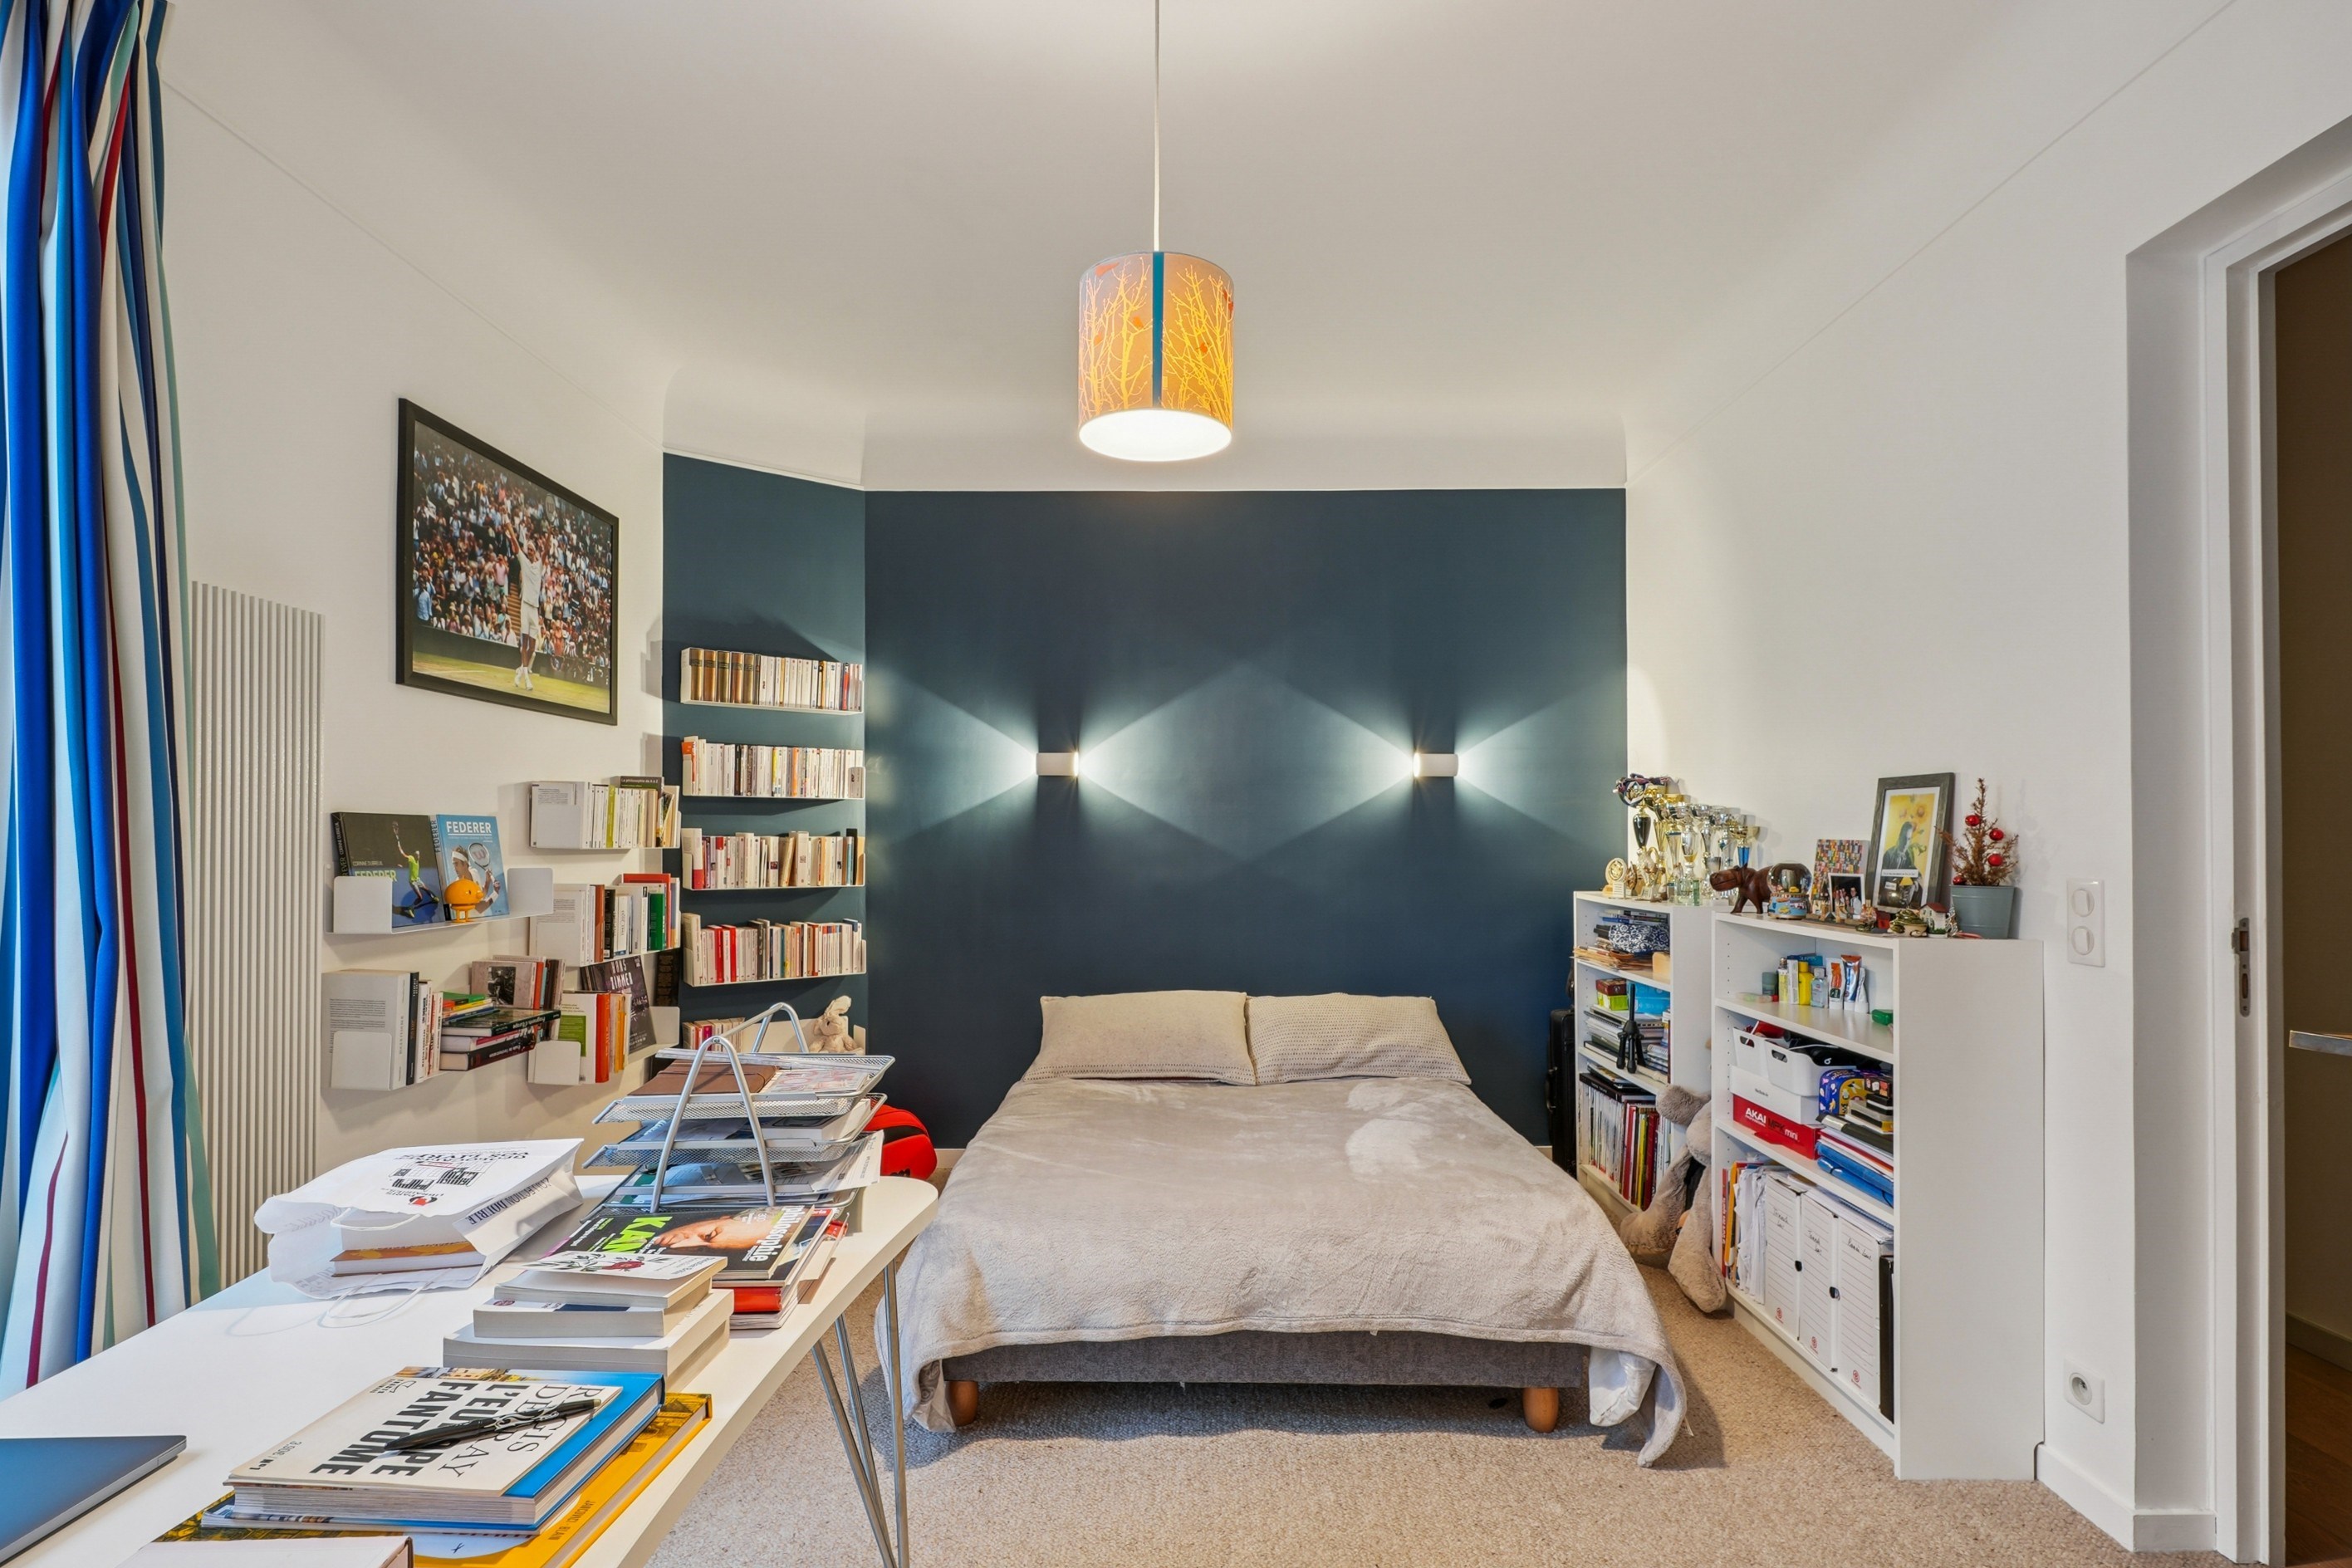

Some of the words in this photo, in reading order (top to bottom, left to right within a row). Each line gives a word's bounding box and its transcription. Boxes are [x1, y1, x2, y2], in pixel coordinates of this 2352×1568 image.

[431, 820, 440, 853] FEDERER
[446, 821, 492, 834] FEDERER
[610, 958, 627, 974] HANS
[610, 972, 634, 990] ZIMMER
[1745, 1107, 1766, 1124] AKAI
[1784, 1129, 1799, 1140] mini
[602, 1216, 673, 1254] KAN
[308, 1381, 480, 1476] FANTOME
[372, 1384, 530, 1477] L'EUPE
[438, 1384, 571, 1477] DERAY
[507, 1385, 605, 1453] RGIS
[568, 1499, 596, 1526] JANCOVICI
